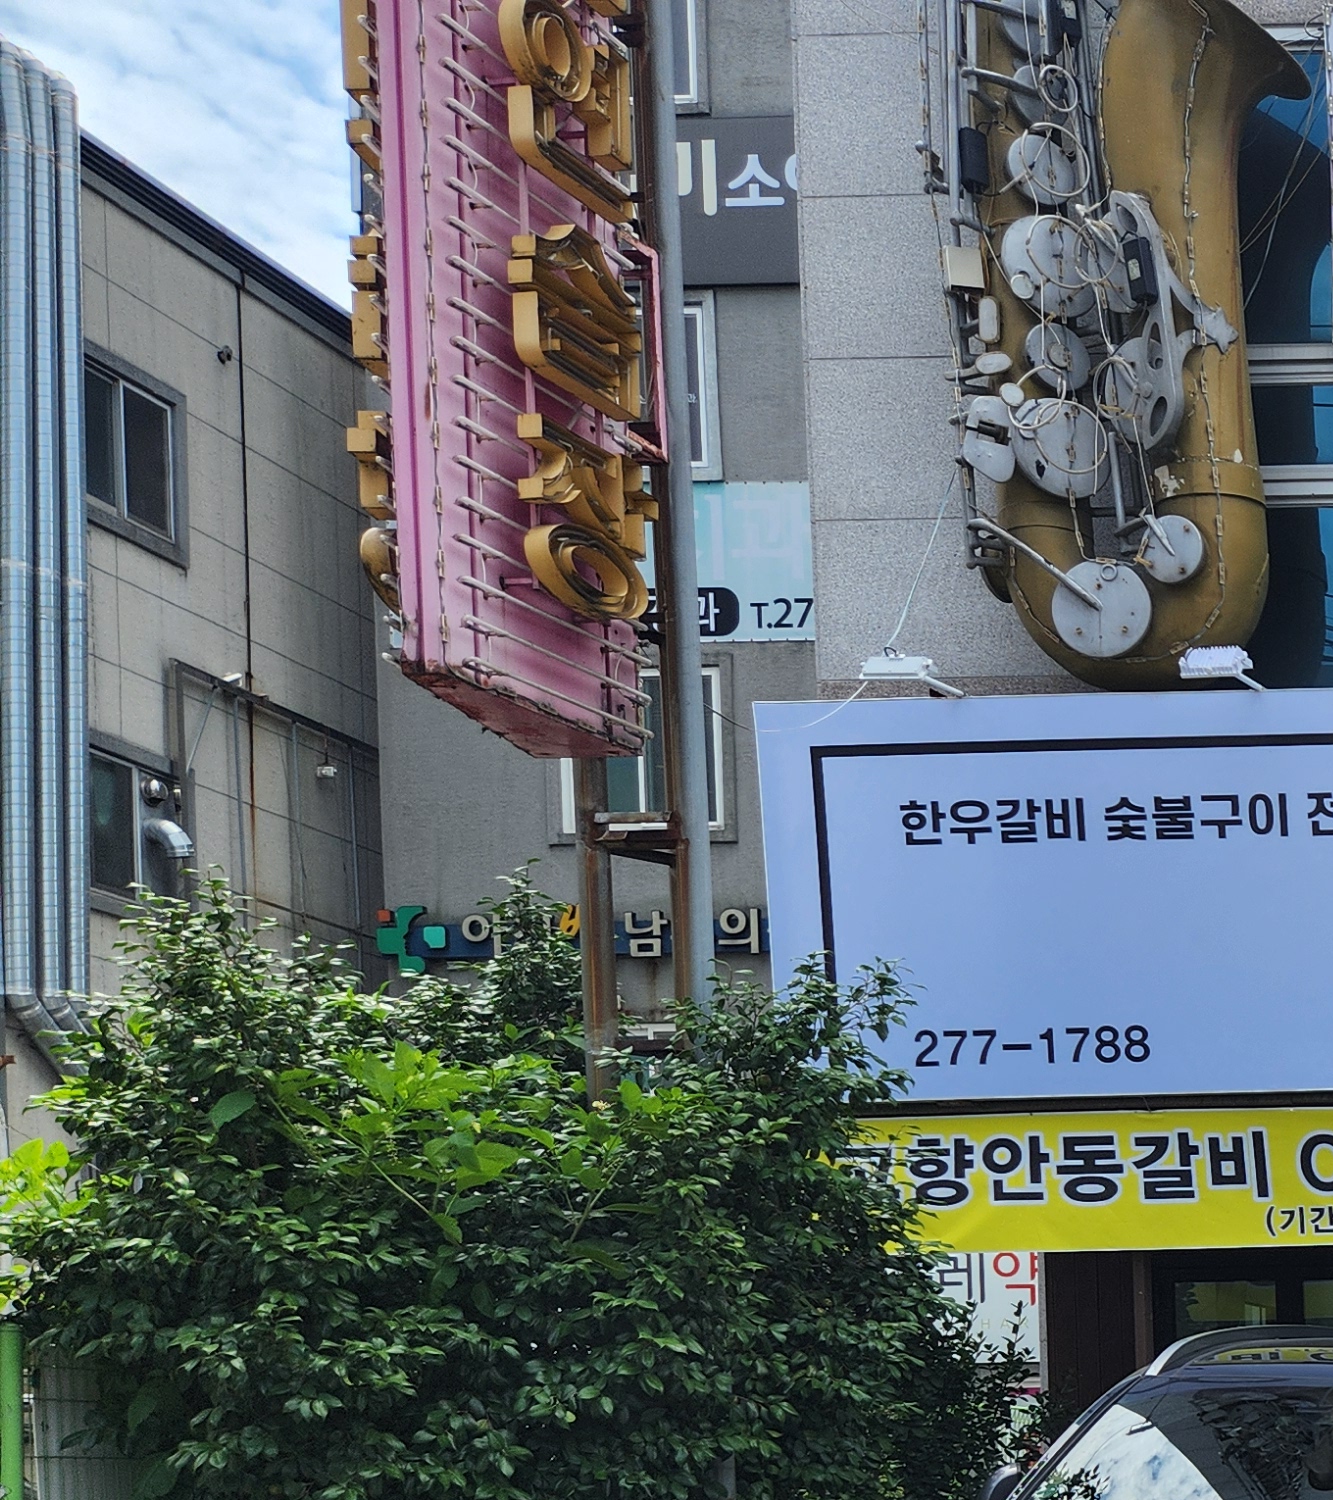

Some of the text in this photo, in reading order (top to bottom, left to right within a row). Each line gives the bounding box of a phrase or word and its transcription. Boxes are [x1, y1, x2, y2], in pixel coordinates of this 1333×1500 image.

[900, 797, 1087, 847] 한우갈비
[1103, 792, 1289, 840] 숯불구이
[913, 1025, 1151, 1069] 277-1788
